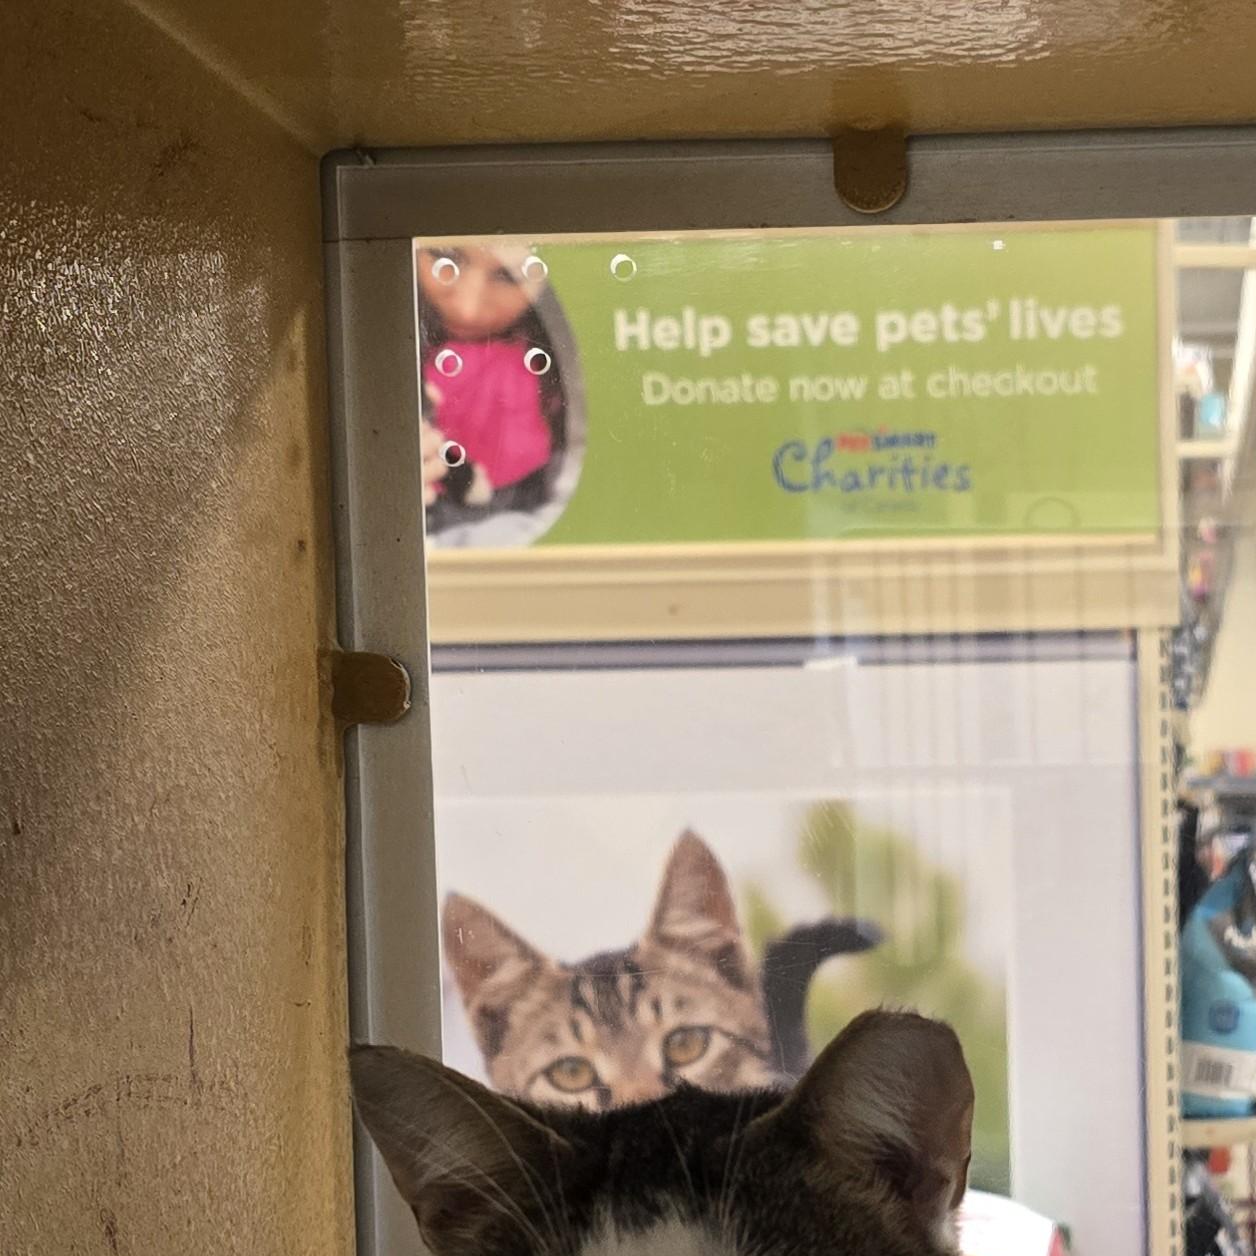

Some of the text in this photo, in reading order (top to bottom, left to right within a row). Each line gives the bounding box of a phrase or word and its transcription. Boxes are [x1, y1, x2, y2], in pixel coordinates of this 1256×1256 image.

[613, 296, 1125, 358] Help save pets' lives
[641, 361, 1099, 406] Donate now at checkout
[771, 436, 974, 495] Charities
